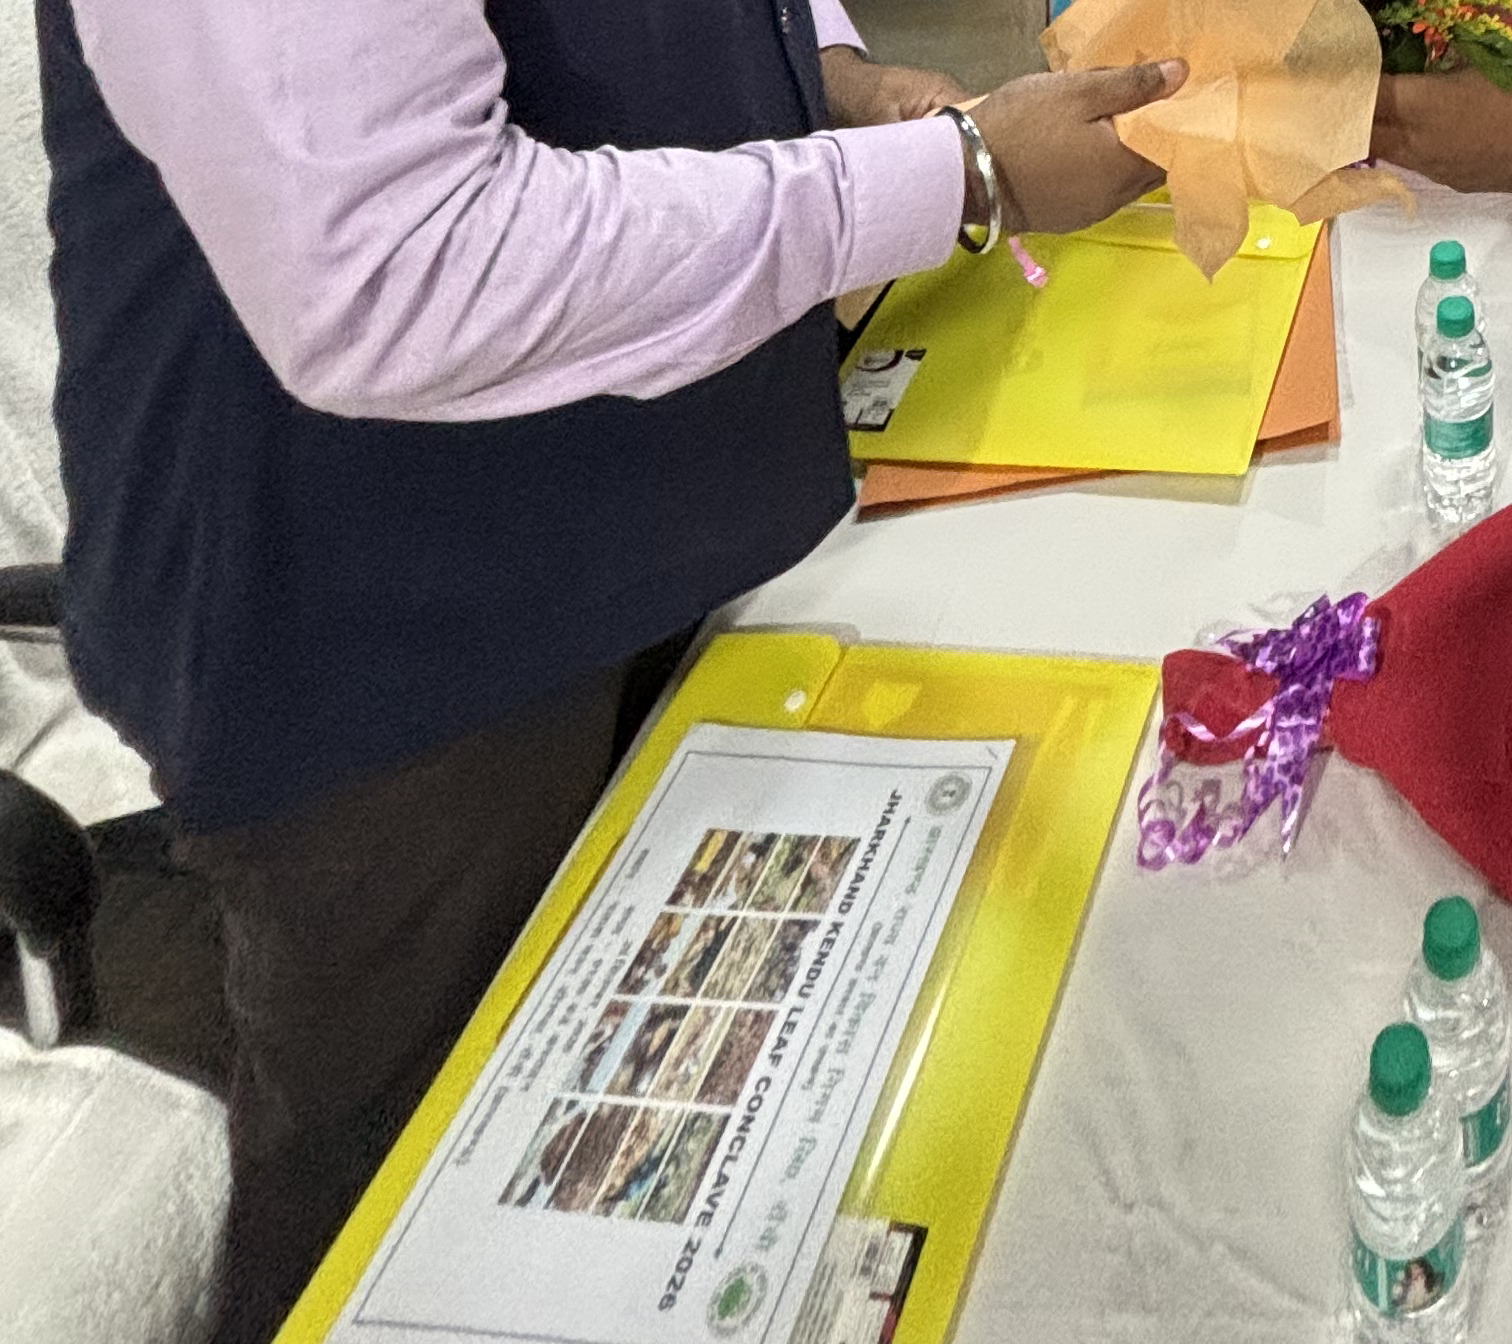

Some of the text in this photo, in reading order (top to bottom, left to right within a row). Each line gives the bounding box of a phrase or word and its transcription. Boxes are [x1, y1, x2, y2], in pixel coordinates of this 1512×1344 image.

[838, 789, 902, 915] JHARKHAND
[798, 922, 844, 998] KENDU
[769, 1006, 804, 1067] LEAF
[695, 1076, 772, 1227] CONCLAVE
[658, 1237, 701, 1311] 2026
